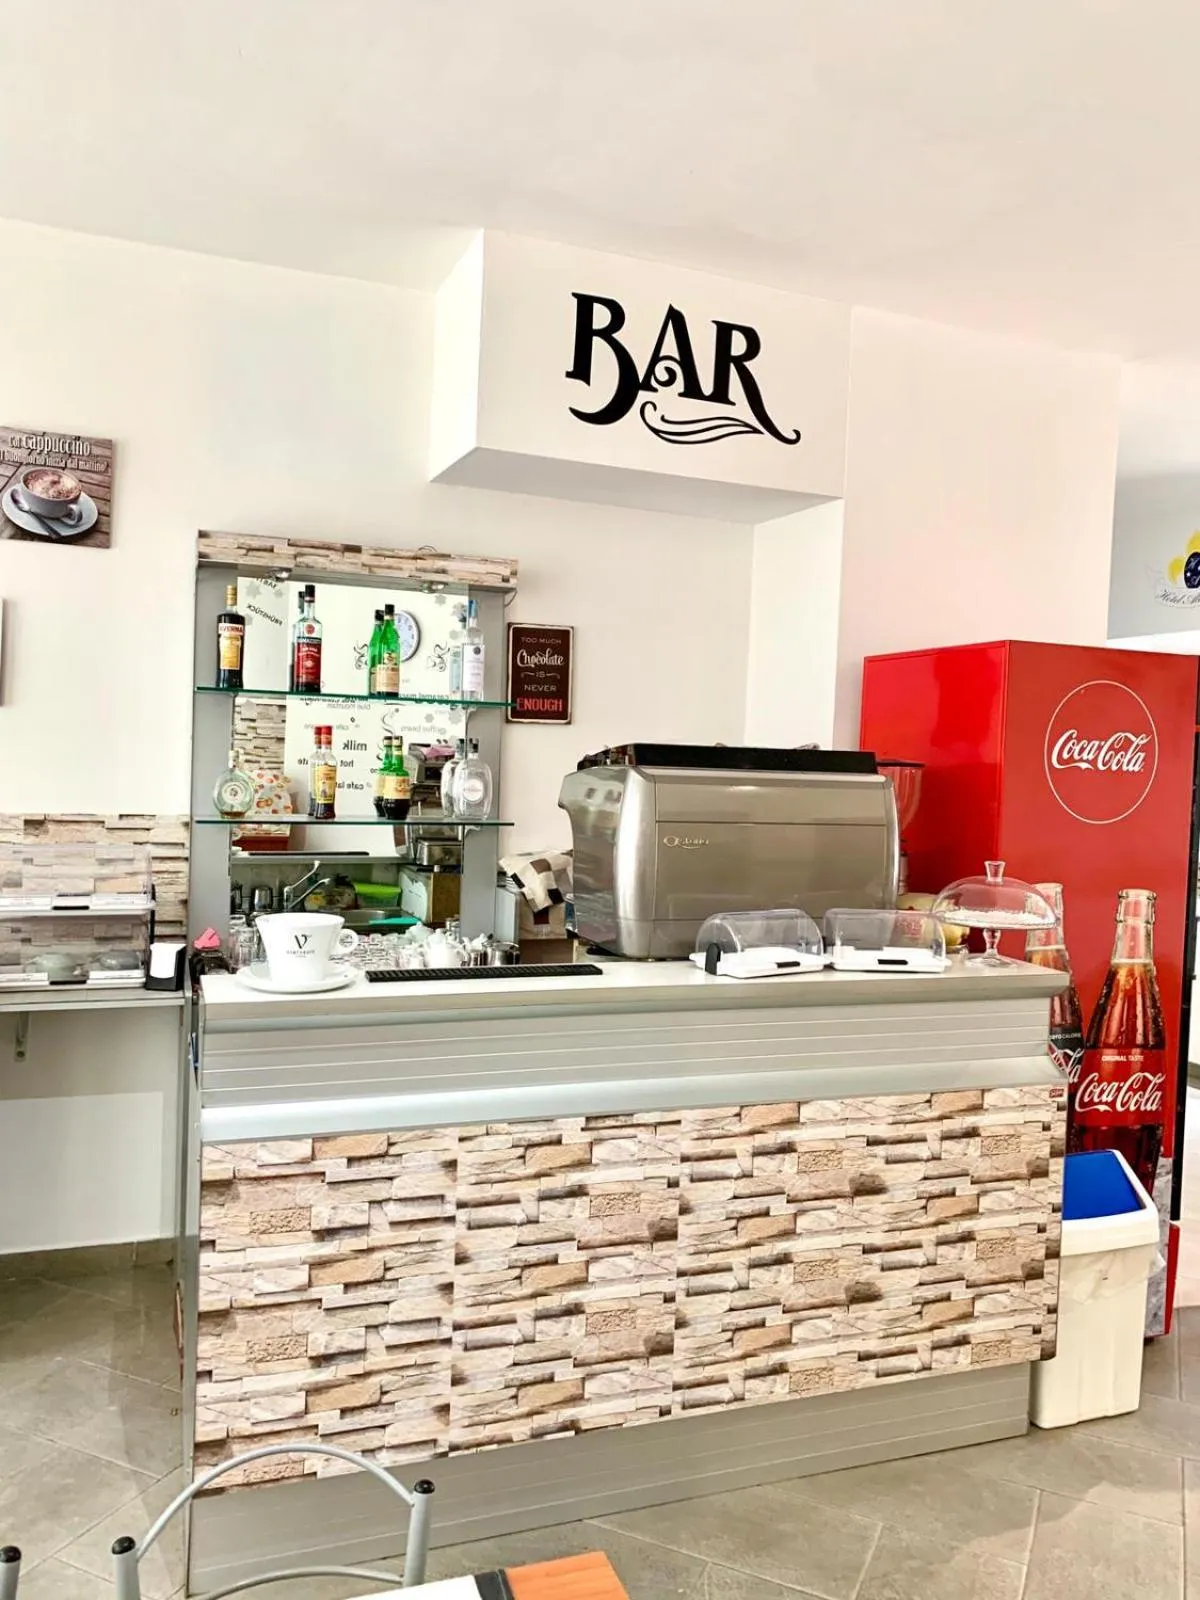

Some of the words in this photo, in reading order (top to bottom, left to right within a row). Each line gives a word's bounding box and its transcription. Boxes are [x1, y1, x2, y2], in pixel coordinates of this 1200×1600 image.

[565, 292, 801, 445] BAR
[516, 648, 566, 668] Chocolate
[524, 684, 557, 692] NEVER
[516, 697, 563, 712] ENOUGH
[1051, 729, 1153, 772] Coca-Cola
[1075, 1072, 1167, 1112] Coca-Cola
